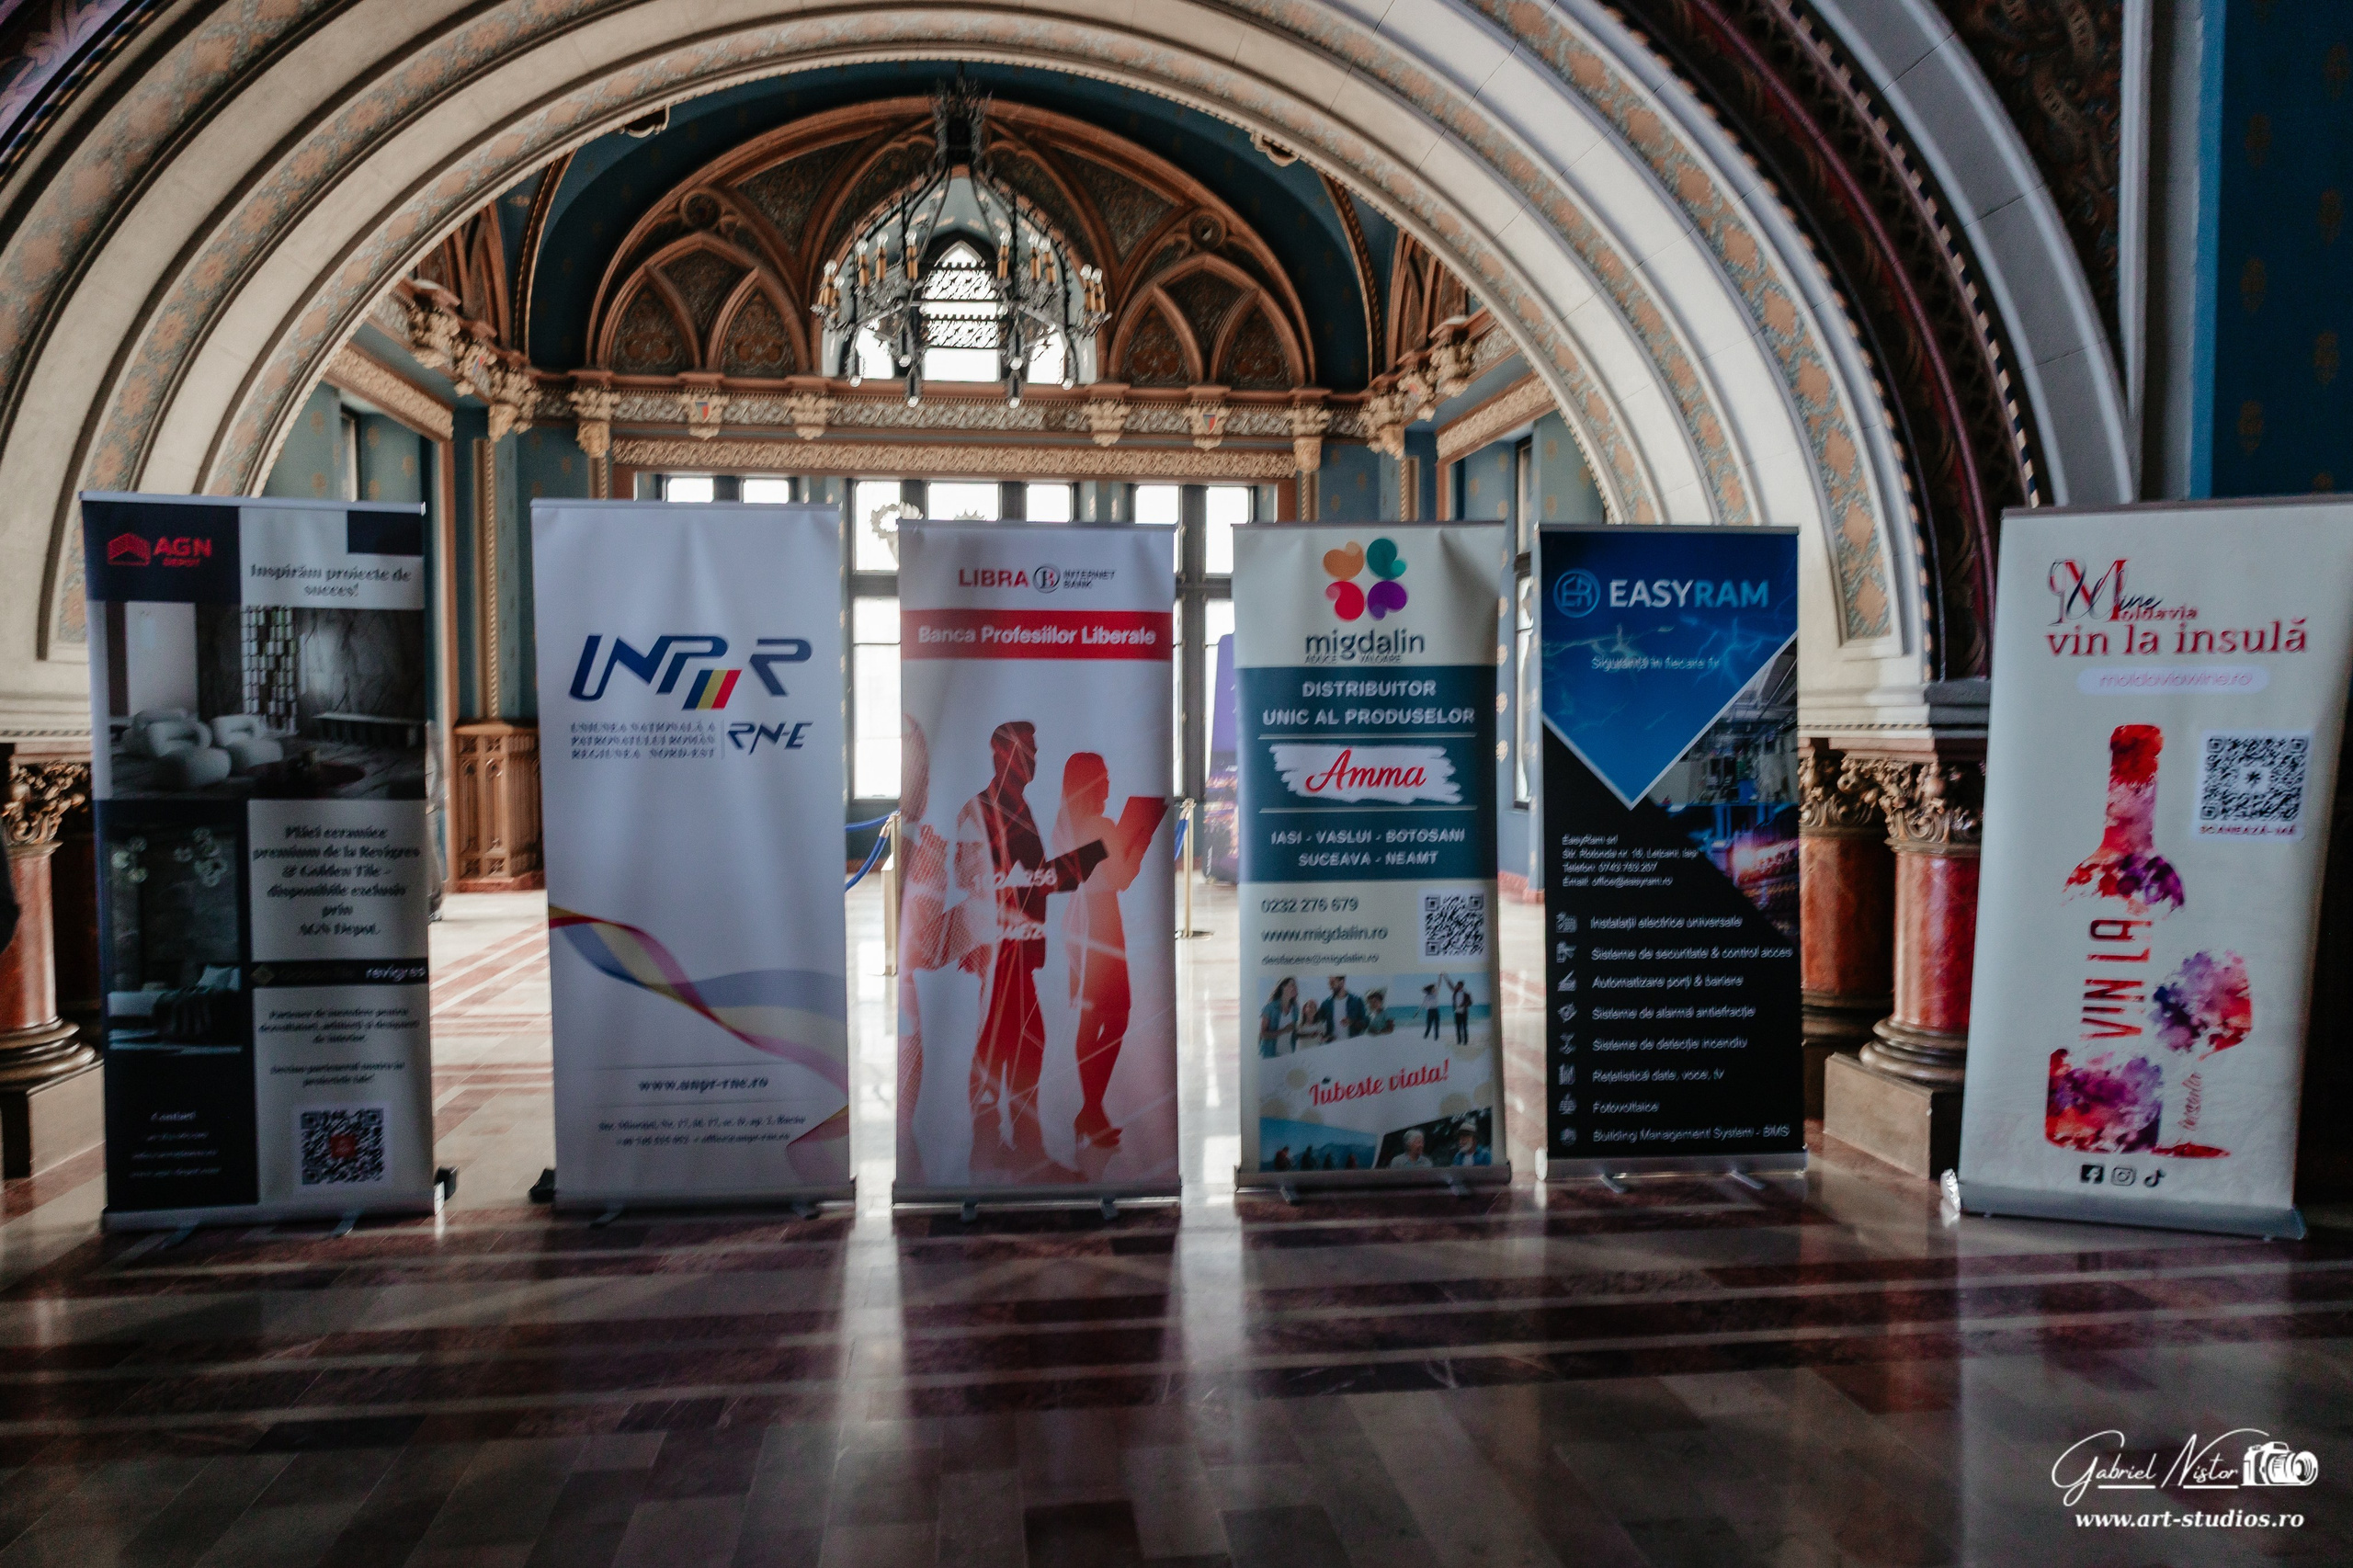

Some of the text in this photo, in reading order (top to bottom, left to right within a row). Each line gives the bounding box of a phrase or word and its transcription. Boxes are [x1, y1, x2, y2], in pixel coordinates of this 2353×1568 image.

[153, 537, 212, 557] AGN
[325, 565, 389, 583] proiecte
[392, 565, 411, 582] de
[959, 568, 1029, 588] LIBRA
[1063, 568, 1116, 581] INTERNET
[1063, 578, 1094, 589] BANK
[1609, 579, 1769, 608] EASYRAM
[918, 625, 1157, 645] Banca Profesiilor Liberale
[2047, 615, 2310, 657] vin la insulă
[1305, 628, 1426, 661] migdalin
[1302, 679, 1437, 698] DISTRIBUITOR
[2098, 671, 2254, 688] moldaviawine.ro
[1262, 707, 1475, 725] UNIC AL PRODUSELOR
[1304, 746, 1428, 793] Amma
[324, 825, 387, 839] ceramice
[1270, 830, 1302, 845] IASI
[1315, 829, 1372, 845] VASLUI
[1385, 827, 1465, 844] BOTOSANI
[253, 846, 320, 860] premium
[324, 845, 339, 858] de
[344, 845, 356, 858] la
[1298, 851, 1371, 867] SUCEAVA
[1385, 849, 1439, 865] NEAMT
[1261, 895, 1359, 914] 0232 276 679
[1638, 916, 1685, 929] electrice
[1686, 915, 1743, 928] universale
[1261, 925, 1388, 944] www.migdalin.ro
[1591, 945, 1794, 960] Sisteme de securitate & control acces
[366, 964, 426, 982] revigres
[1592, 975, 1665, 989] Automatizare
[1693, 974, 1703, 987] &
[1704, 974, 1744, 987] bariere
[2079, 917, 2154, 1040] VIN LA
[1592, 1006, 1638, 1020] Sisteme
[1639, 1007, 1654, 1019] de
[1592, 1038, 1638, 1051] Sisteme
[1639, 1038, 1654, 1051] de
[1701, 1036, 1748, 1050] incendiu
[1308, 1057, 1450, 1107] Iubeste viata!
[1651, 1068, 1680, 1082] date,
[1681, 1070, 1711, 1082] voce,
[1713, 1067, 1724, 1080] tv
[638, 1076, 768, 1094] www.unpr-rne.ro
[1593, 1100, 1660, 1114] Fotovoltaice
[1593, 1128, 1638, 1143] Building
[1640, 1126, 1711, 1142] Management
[1713, 1125, 1755, 1141] System
[1763, 1123, 1790, 1138] BMS
